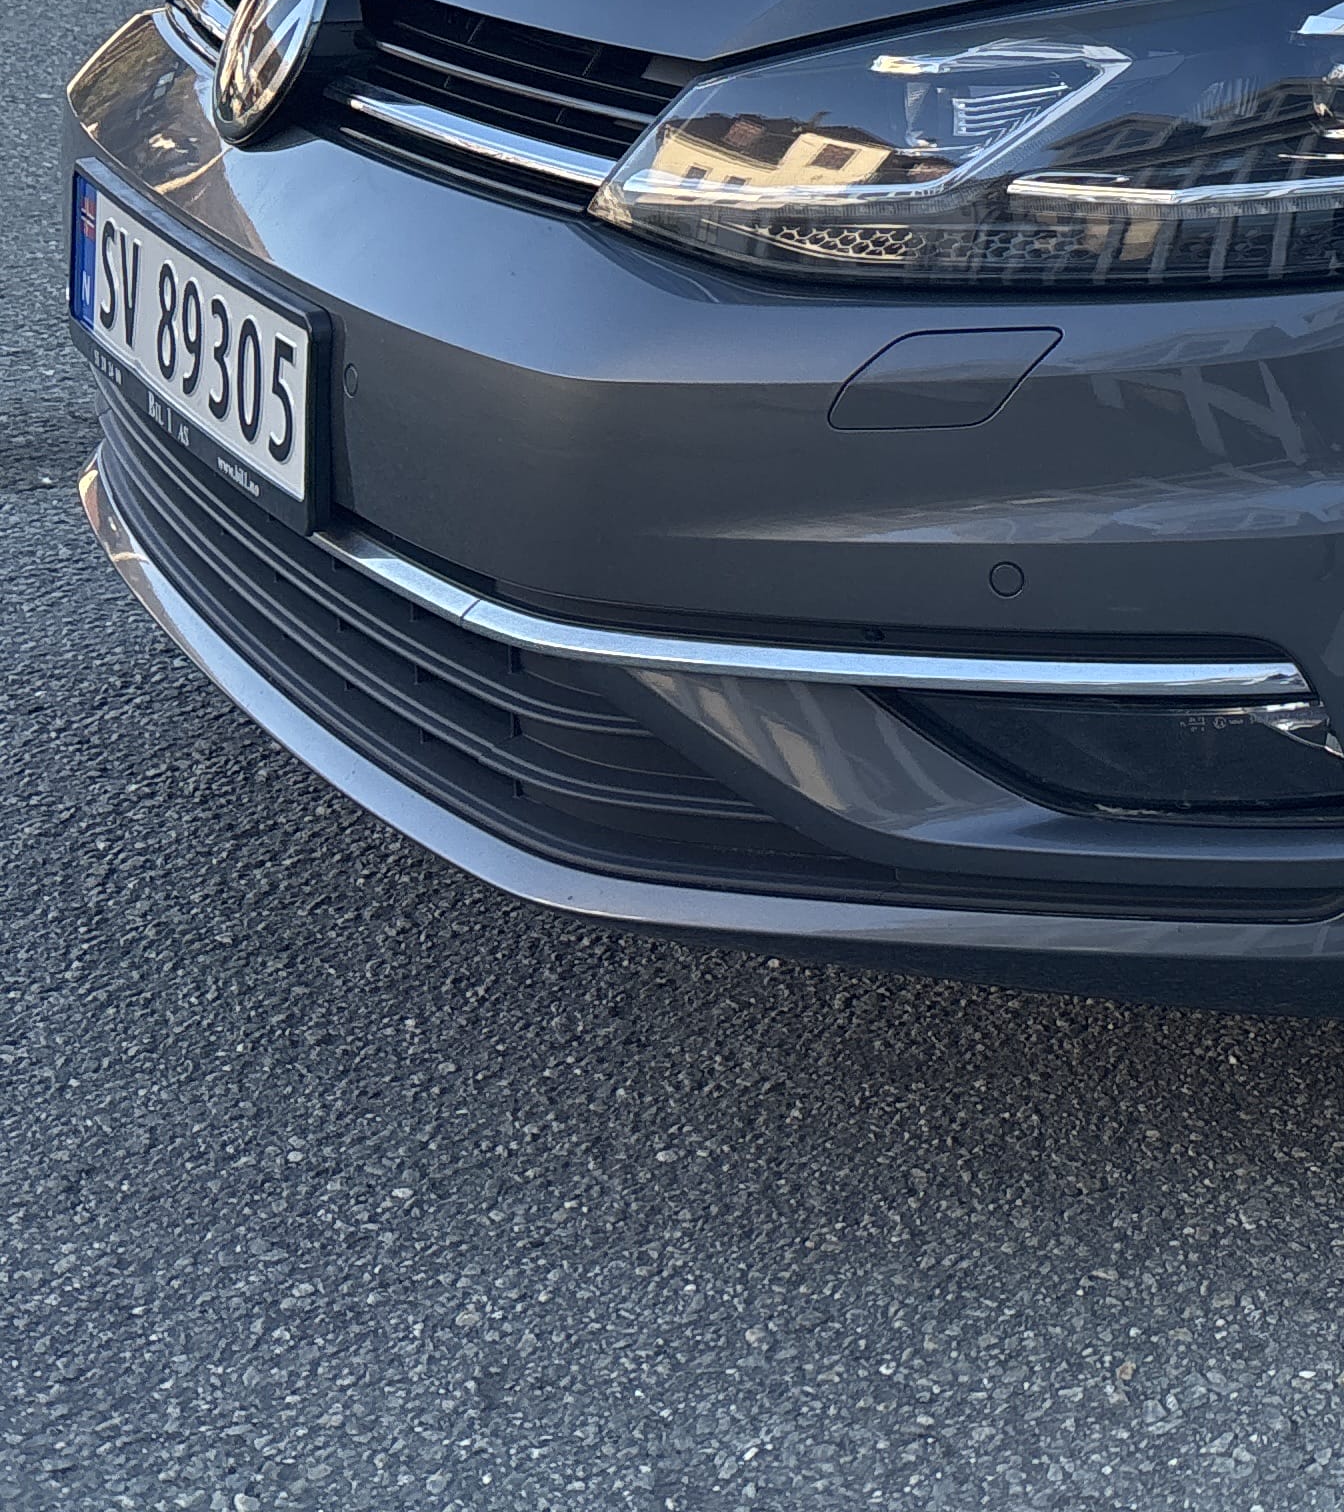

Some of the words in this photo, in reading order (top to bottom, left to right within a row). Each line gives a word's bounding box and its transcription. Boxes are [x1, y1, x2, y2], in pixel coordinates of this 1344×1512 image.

[82, 270, 92, 306] N
[100, 216, 141, 348] SV
[157, 260, 297, 464] 89305
